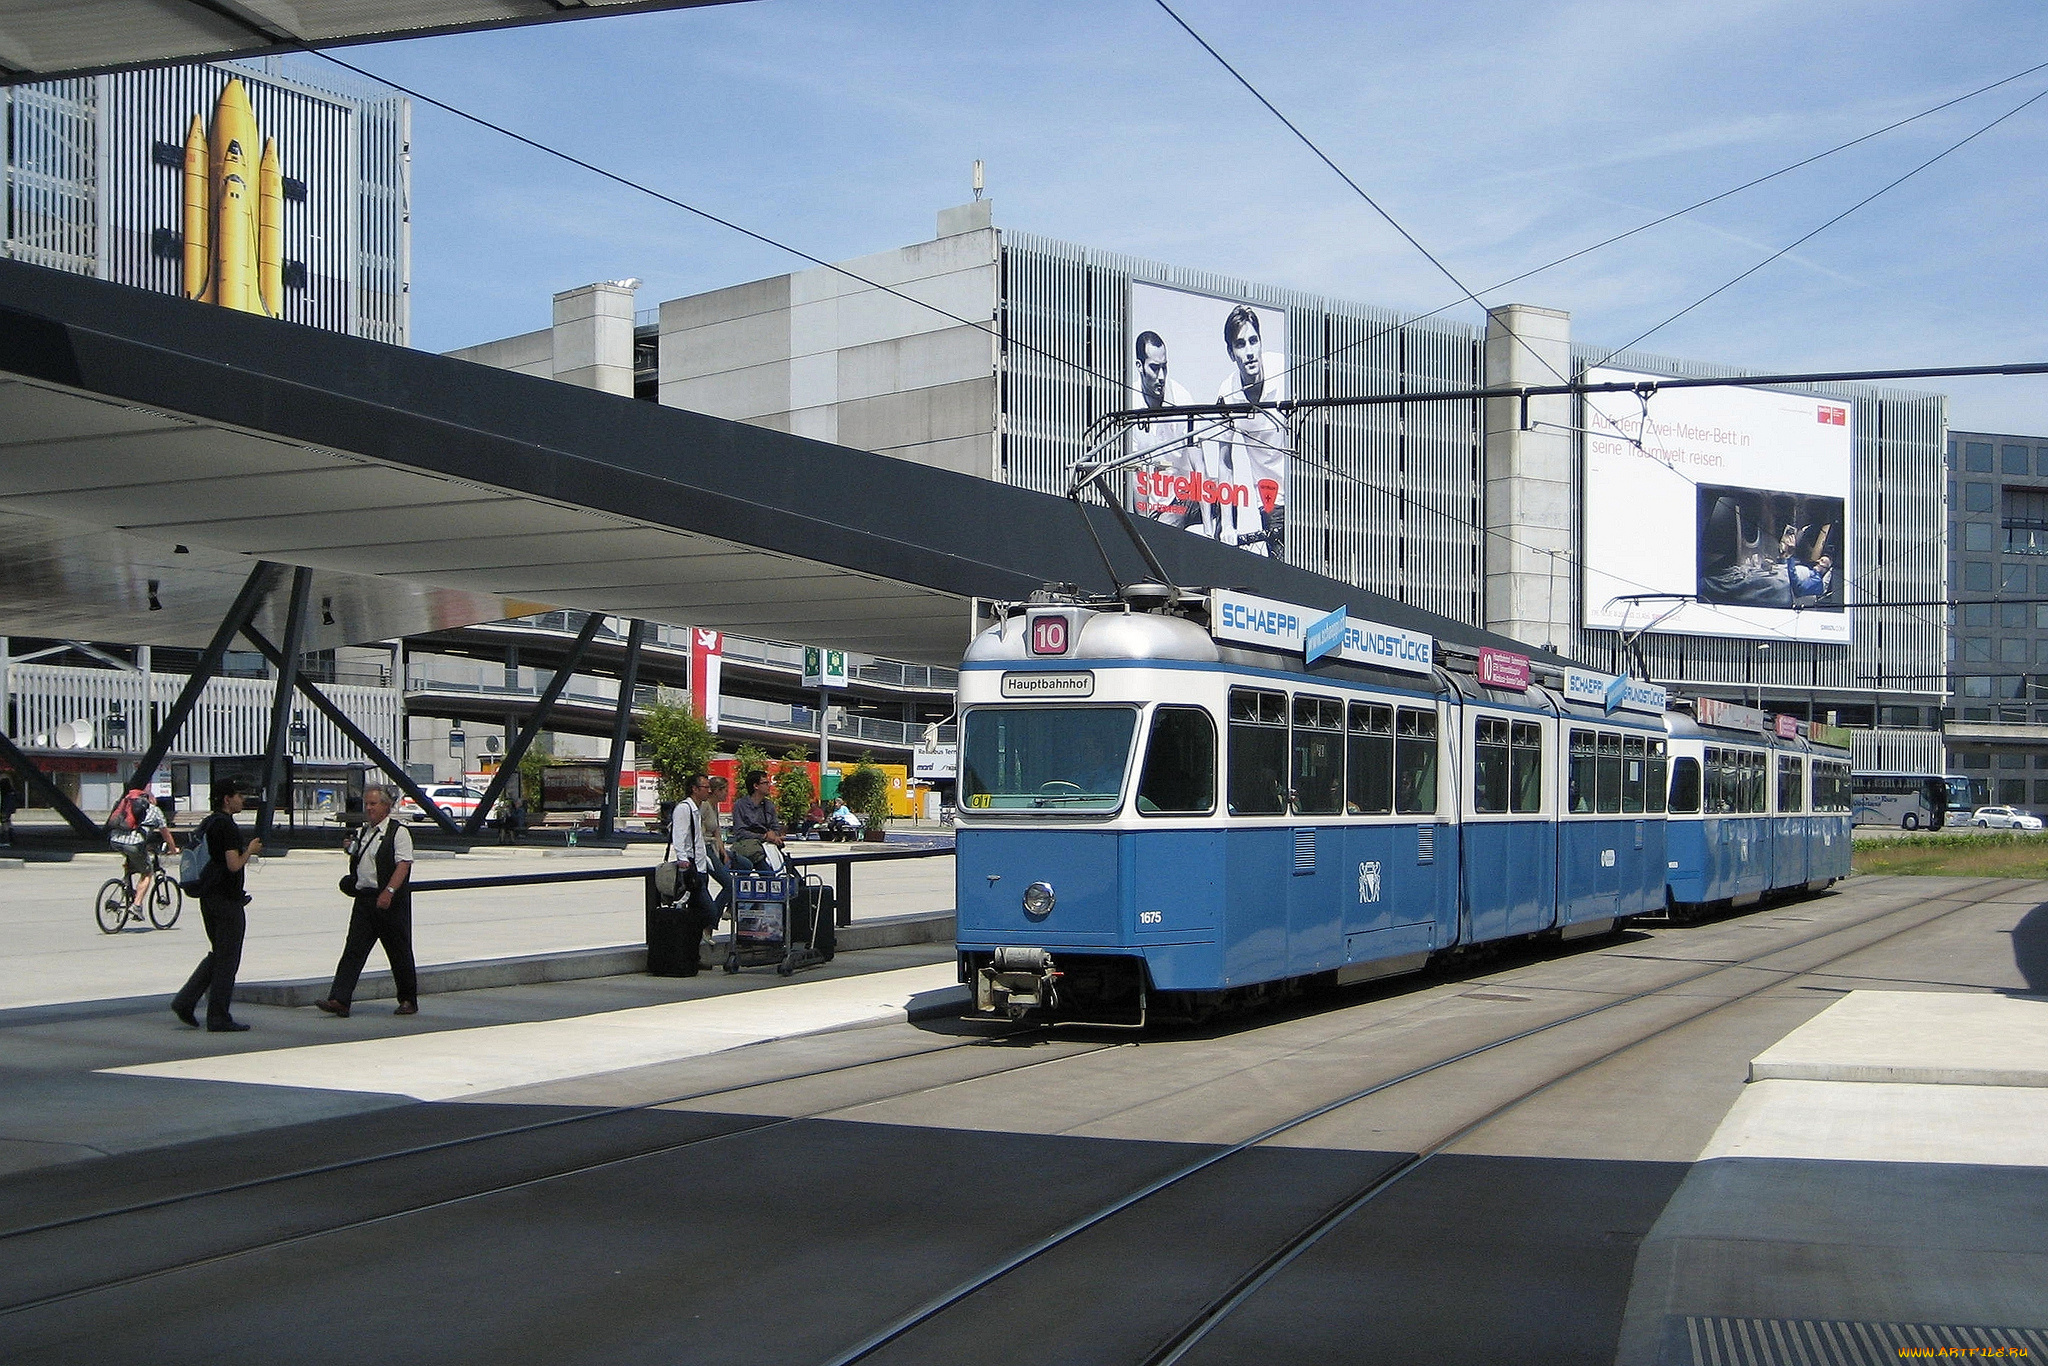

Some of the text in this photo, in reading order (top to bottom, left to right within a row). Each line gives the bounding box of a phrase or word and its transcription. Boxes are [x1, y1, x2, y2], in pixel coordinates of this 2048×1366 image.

[1592, 412, 1751, 447] Auf dem Zwei-Meter-Bett in
[1592, 440, 1623, 456] seine
[1689, 451, 1726, 468] reisen.
[1136, 470, 1249, 508] strellson
[1222, 602, 1300, 640] SCHAEPPI
[1037, 623, 1065, 649] 10
[1343, 627, 1430, 664] GRUNDSTÜCKE
[1483, 653, 1493, 681] 10
[1008, 678, 1089, 692] Hauptbahnhof
[1139, 911, 1162, 924] 1675
